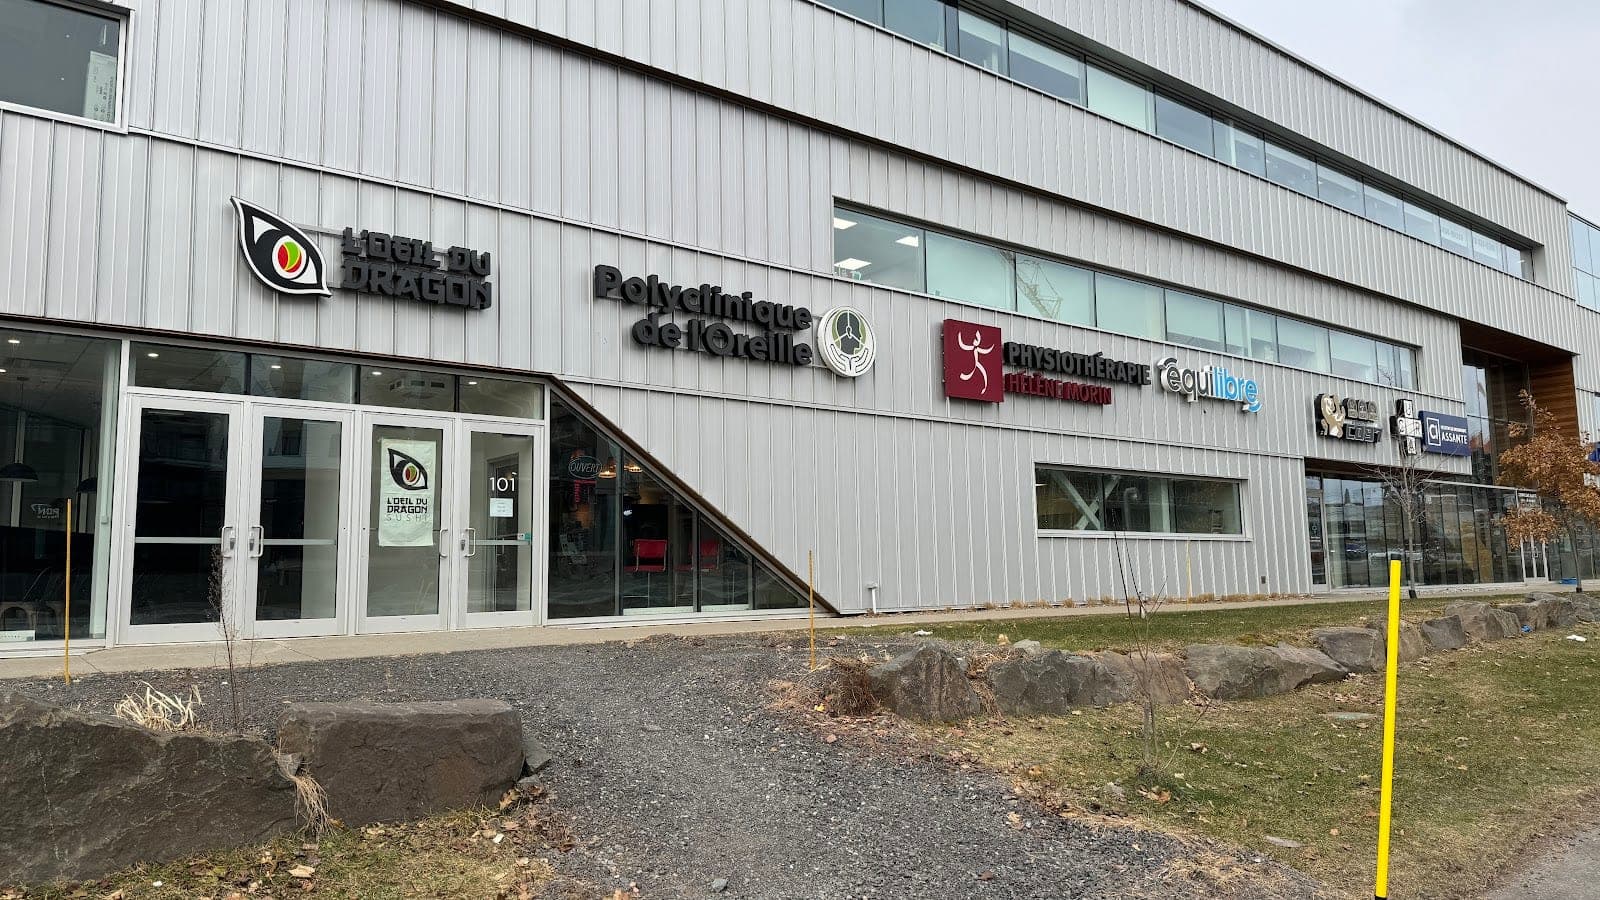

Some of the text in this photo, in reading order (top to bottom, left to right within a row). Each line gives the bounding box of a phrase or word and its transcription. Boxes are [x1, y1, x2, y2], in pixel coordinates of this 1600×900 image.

[448, 245, 491, 276] DU
[343, 258, 492, 310] DRAGON
[595, 264, 812, 330] Polyclinique
[632, 312, 813, 366] de l'Oreille
[1004, 341, 1151, 385] PHYSIOTHÉRAPIE
[1005, 369, 1112, 405] HÉLÈNE MORIN
[1441, 431, 1468, 445] ASSANTE
[570, 462, 601, 473] OUVERT
[489, 477, 515, 492] 101
[387, 505, 428, 514] DRAGON
[416, 497, 428, 506] DU
[386, 514, 428, 522] SUSHI
